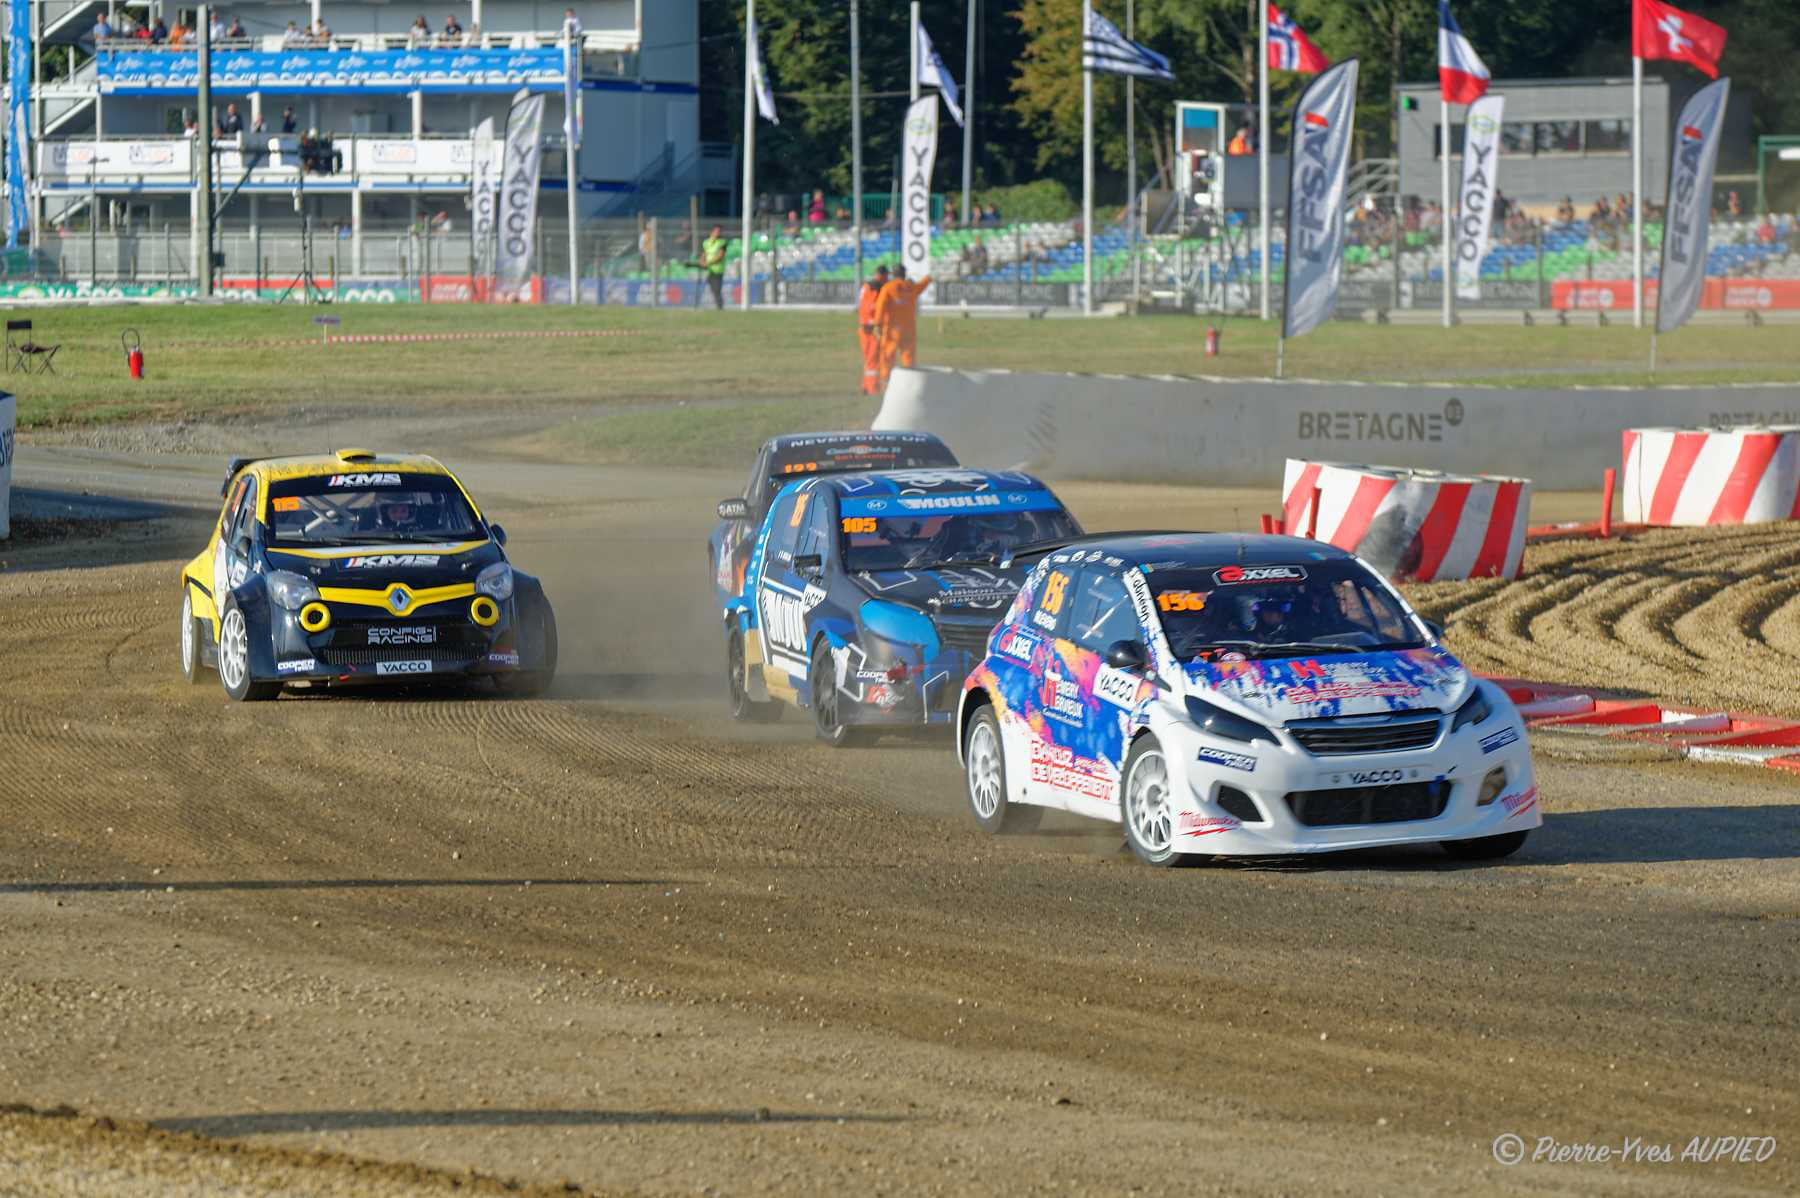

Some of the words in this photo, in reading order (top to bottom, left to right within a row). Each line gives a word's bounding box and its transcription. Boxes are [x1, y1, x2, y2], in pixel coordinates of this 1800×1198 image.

[507, 144, 533, 258] YACCO
[907, 146, 929, 262] YACCO
[1458, 142, 1492, 262] YACCO
[1298, 411, 1443, 442] BRETAGNE
[790, 436, 850, 448] NEVER
[911, 494, 1000, 509] MOULIN
[841, 517, 877, 533] 105
[1041, 570, 1070, 616] 156
[1156, 594, 1206, 612] 156
[367, 634, 433, 646] RACING
[382, 662, 428, 673] YACCO
[1100, 673, 1134, 702] YACCO
[1200, 747, 1256, 765] COOPER
[1349, 769, 1403, 785] YACCO
